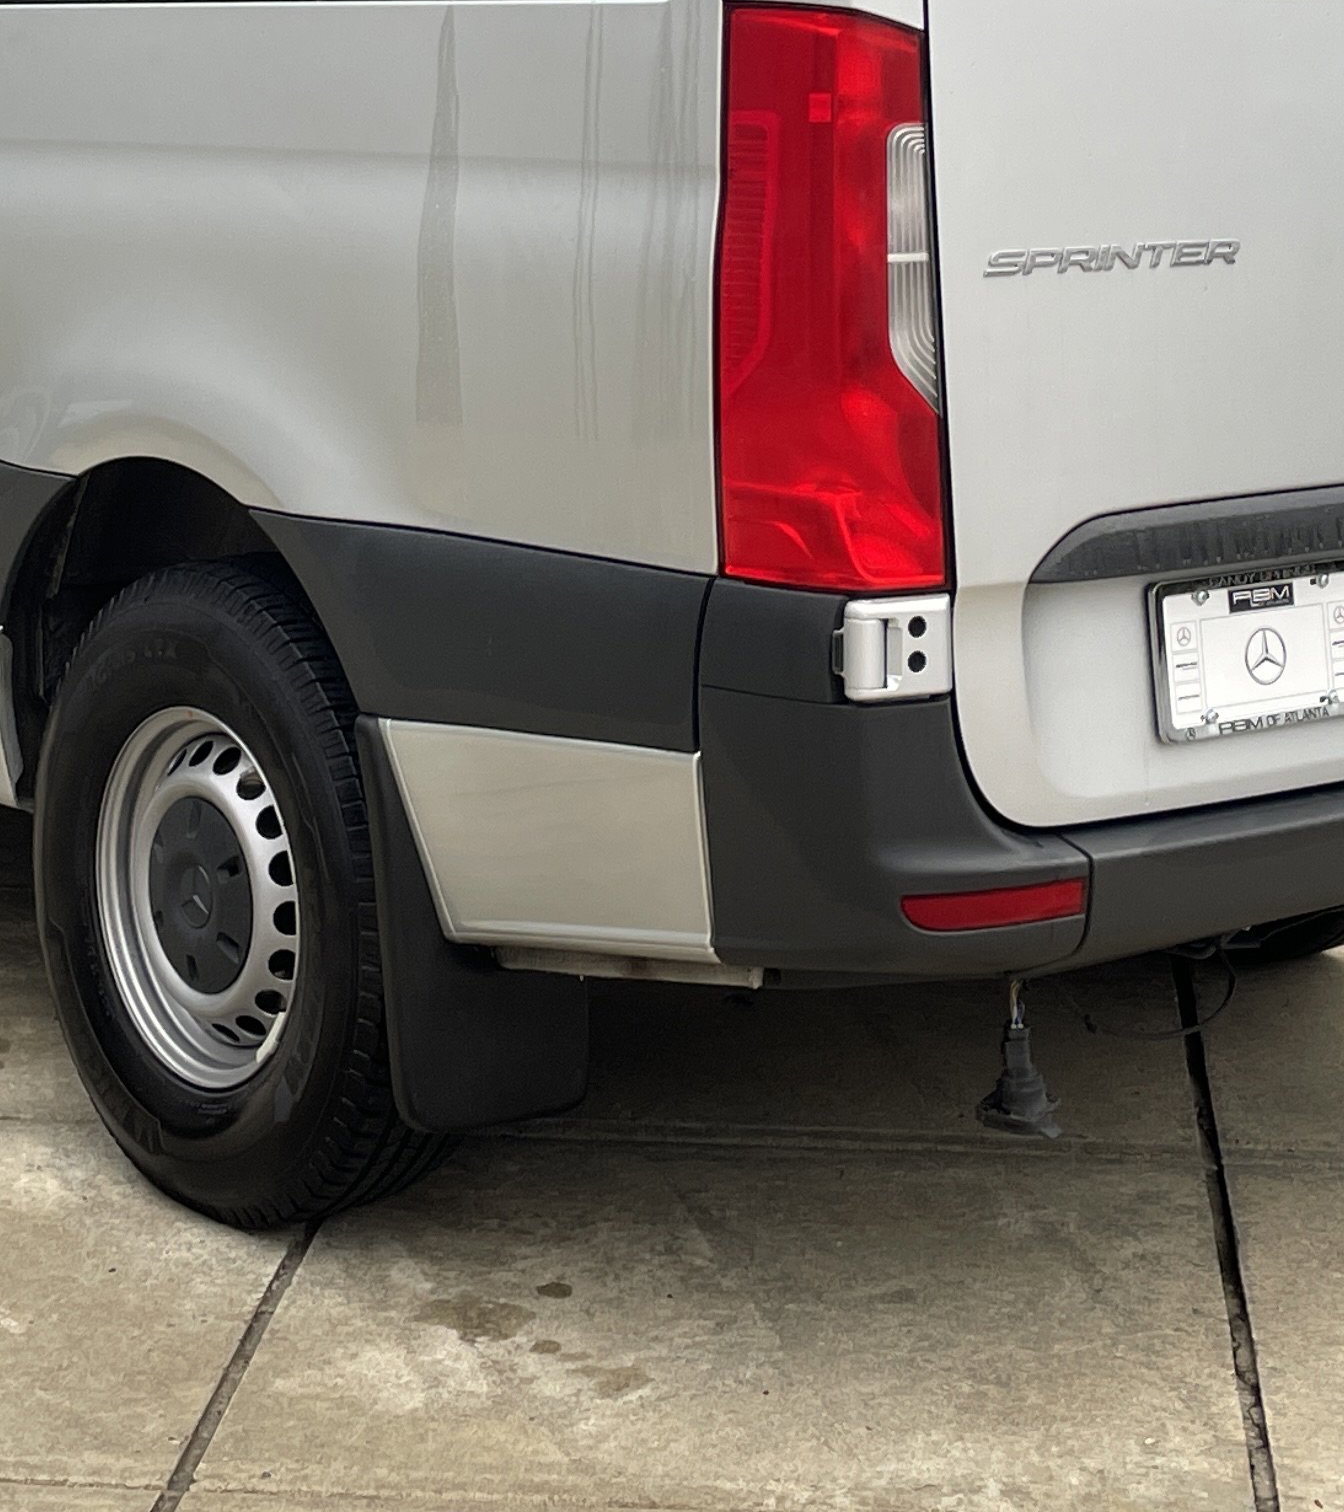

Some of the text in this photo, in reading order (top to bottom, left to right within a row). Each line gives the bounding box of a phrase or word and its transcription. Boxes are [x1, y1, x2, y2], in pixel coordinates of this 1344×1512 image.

[983, 238, 1241, 278] SPRINTER
[1266, 714, 1281, 725] OF
[1284, 706, 1329, 723] ATLANTA
